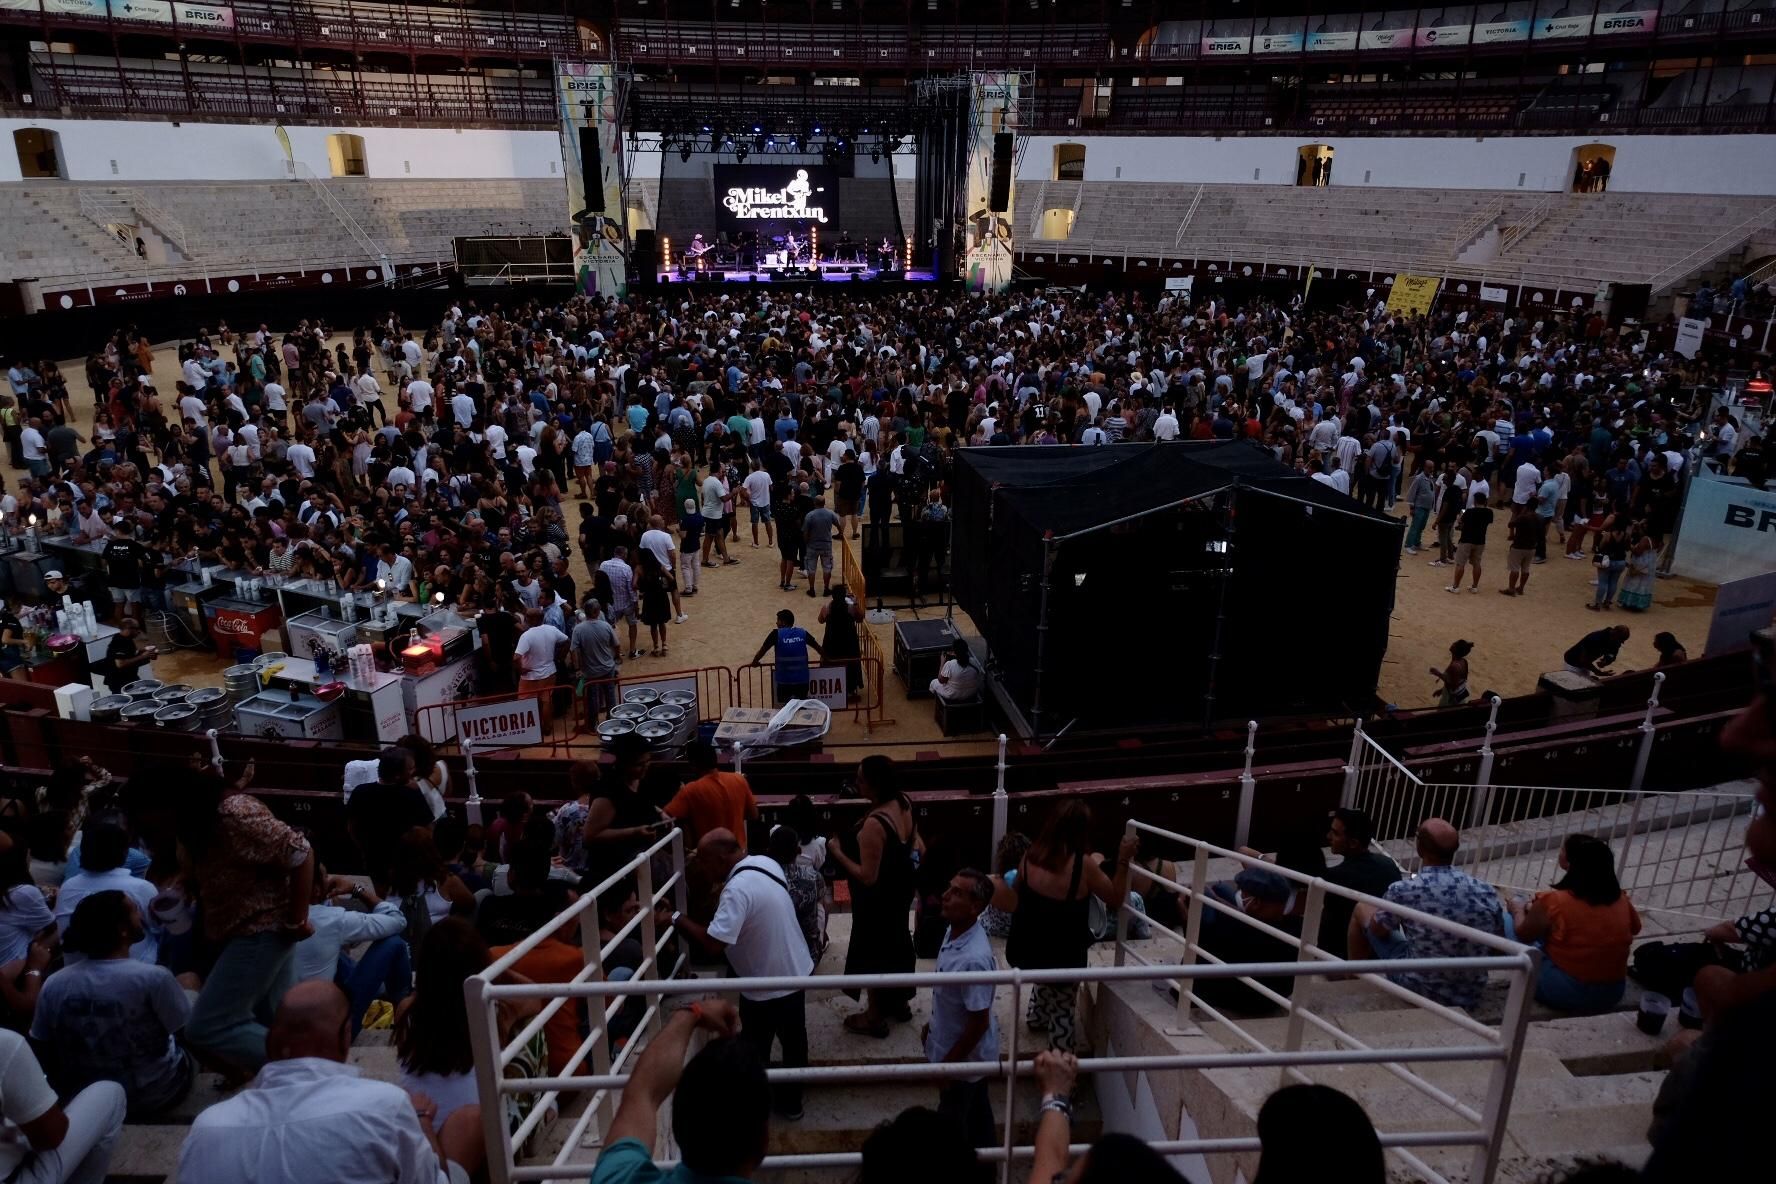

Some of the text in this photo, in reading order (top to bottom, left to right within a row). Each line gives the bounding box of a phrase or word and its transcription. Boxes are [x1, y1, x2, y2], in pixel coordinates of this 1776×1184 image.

[185, 10, 225, 22] BRISA
[1603, 18, 1645, 29] BRISA
[1485, 27, 1517, 35] VICTORIA
[1209, 43, 1242, 51] BRISA
[567, 82, 607, 90] BRISA
[727, 187, 789, 205] Mikel
[809, 678, 843, 695] ORIA
[462, 710, 537, 738] VICTORIA
[509, 729, 527, 737] 1928
